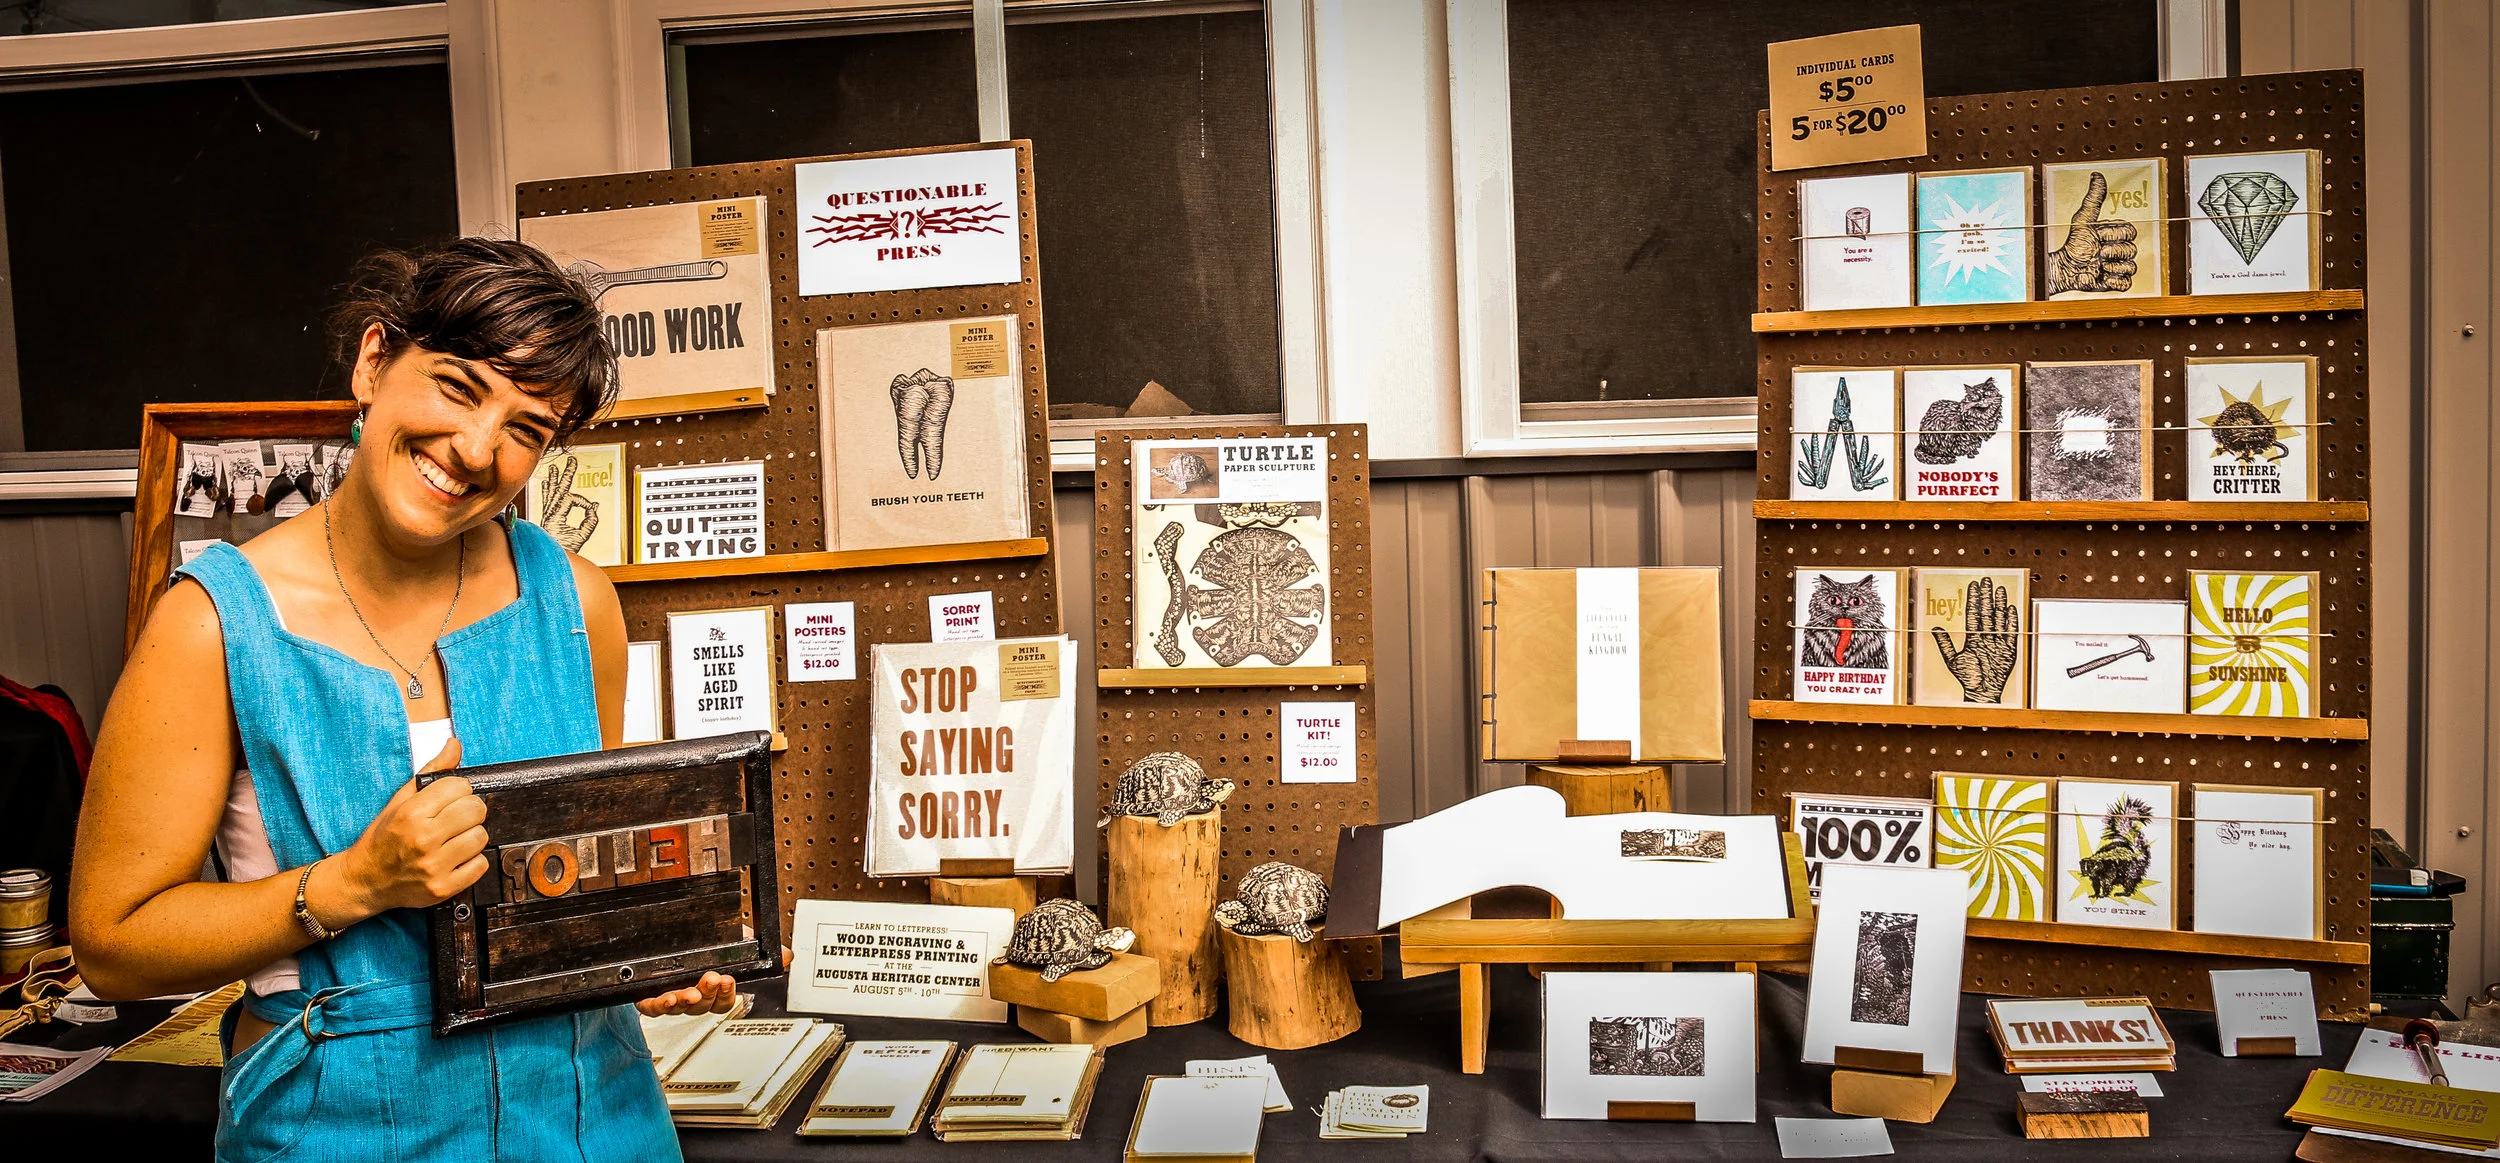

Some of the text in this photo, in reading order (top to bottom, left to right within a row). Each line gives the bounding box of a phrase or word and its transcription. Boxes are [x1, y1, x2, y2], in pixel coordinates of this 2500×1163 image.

[1796, 53, 1895, 76] INDIVIDUAL CARDS
[1791, 116, 1810, 141] 5
[1812, 119, 1833, 131] FOR
[827, 183, 987, 209] QUESTIONABLE
[2108, 180, 2148, 215] yes!
[711, 212, 743, 221] POSTER
[716, 205, 736, 213] MINI
[877, 244, 942, 261] PRESS
[604, 302, 745, 359] OOD WORK
[961, 334, 994, 342] POSTER
[967, 327, 987, 335] MINI
[1223, 445, 1313, 461] TURTLE
[1224, 463, 1316, 472] PAPER SCULPTURE
[2213, 465, 2280, 478] HEY THERE,
[577, 463, 613, 489] nice!
[1918, 471, 1999, 482] NOBODY'S
[1917, 485, 2000, 496] PURRFECT
[2213, 478, 2281, 494] CRITTER
[871, 491, 984, 507] BRUSH YOUR TEETH
[646, 517, 712, 536] QUIT
[646, 536, 757, 559] TRYING
[942, 604, 981, 616] SORRY
[1925, 588, 1963, 622] hey!
[806, 615, 833, 625] MINI
[945, 616, 980, 627] PRINT
[2223, 607, 2273, 623] HELLO
[794, 626, 847, 637] POSTERS
[693, 644, 744, 661] SMELLS
[1012, 653, 1046, 662] POSTER
[1018, 646, 1039, 654] MINI
[703, 662, 736, 677] LIKE
[803, 658, 839, 670] $12.00
[1804, 671, 1887, 684] HAPPY BIRTHDAY
[2208, 665, 2287, 682] SUNSHINE
[703, 679, 738, 694] AGED
[900, 665, 977, 714] STOP
[1829, 686, 1861, 694] CRAZY
[1863, 687, 1883, 695] CAT
[698, 696, 744, 711] SPIRIT
[1296, 718, 1341, 728] TURTLE
[1307, 731, 1331, 740] KIT!
[900, 726, 1014, 777] SAYING
[1300, 757, 1338, 768] $12.00
[898, 789, 1010, 840] SORRY.
[1800, 816, 1923, 864] 100%
[2259, 828, 2287, 838] Birthday
[2083, 906, 2148, 916] YOU STINK
[855, 922, 949, 935] LEARN TO LETTEPRESS!
[836, 933, 965, 950] WOOD ENGRAVING &
[822, 945, 979, 964] LETTERPRESS PRINTING
[884, 962, 913, 971] AT THE
[816, 968, 981, 988] AUGUSTA HERITAGE CENTER
[853, 984, 940, 998] AUGUST 5TH 10TH
[2009, 1019, 2155, 1045] THANKS!
[2336, 1079, 2384, 1092] YOU
[2395, 1088, 2457, 1101] MAKE
[2320, 1084, 2488, 1125] DIFFERENCE
